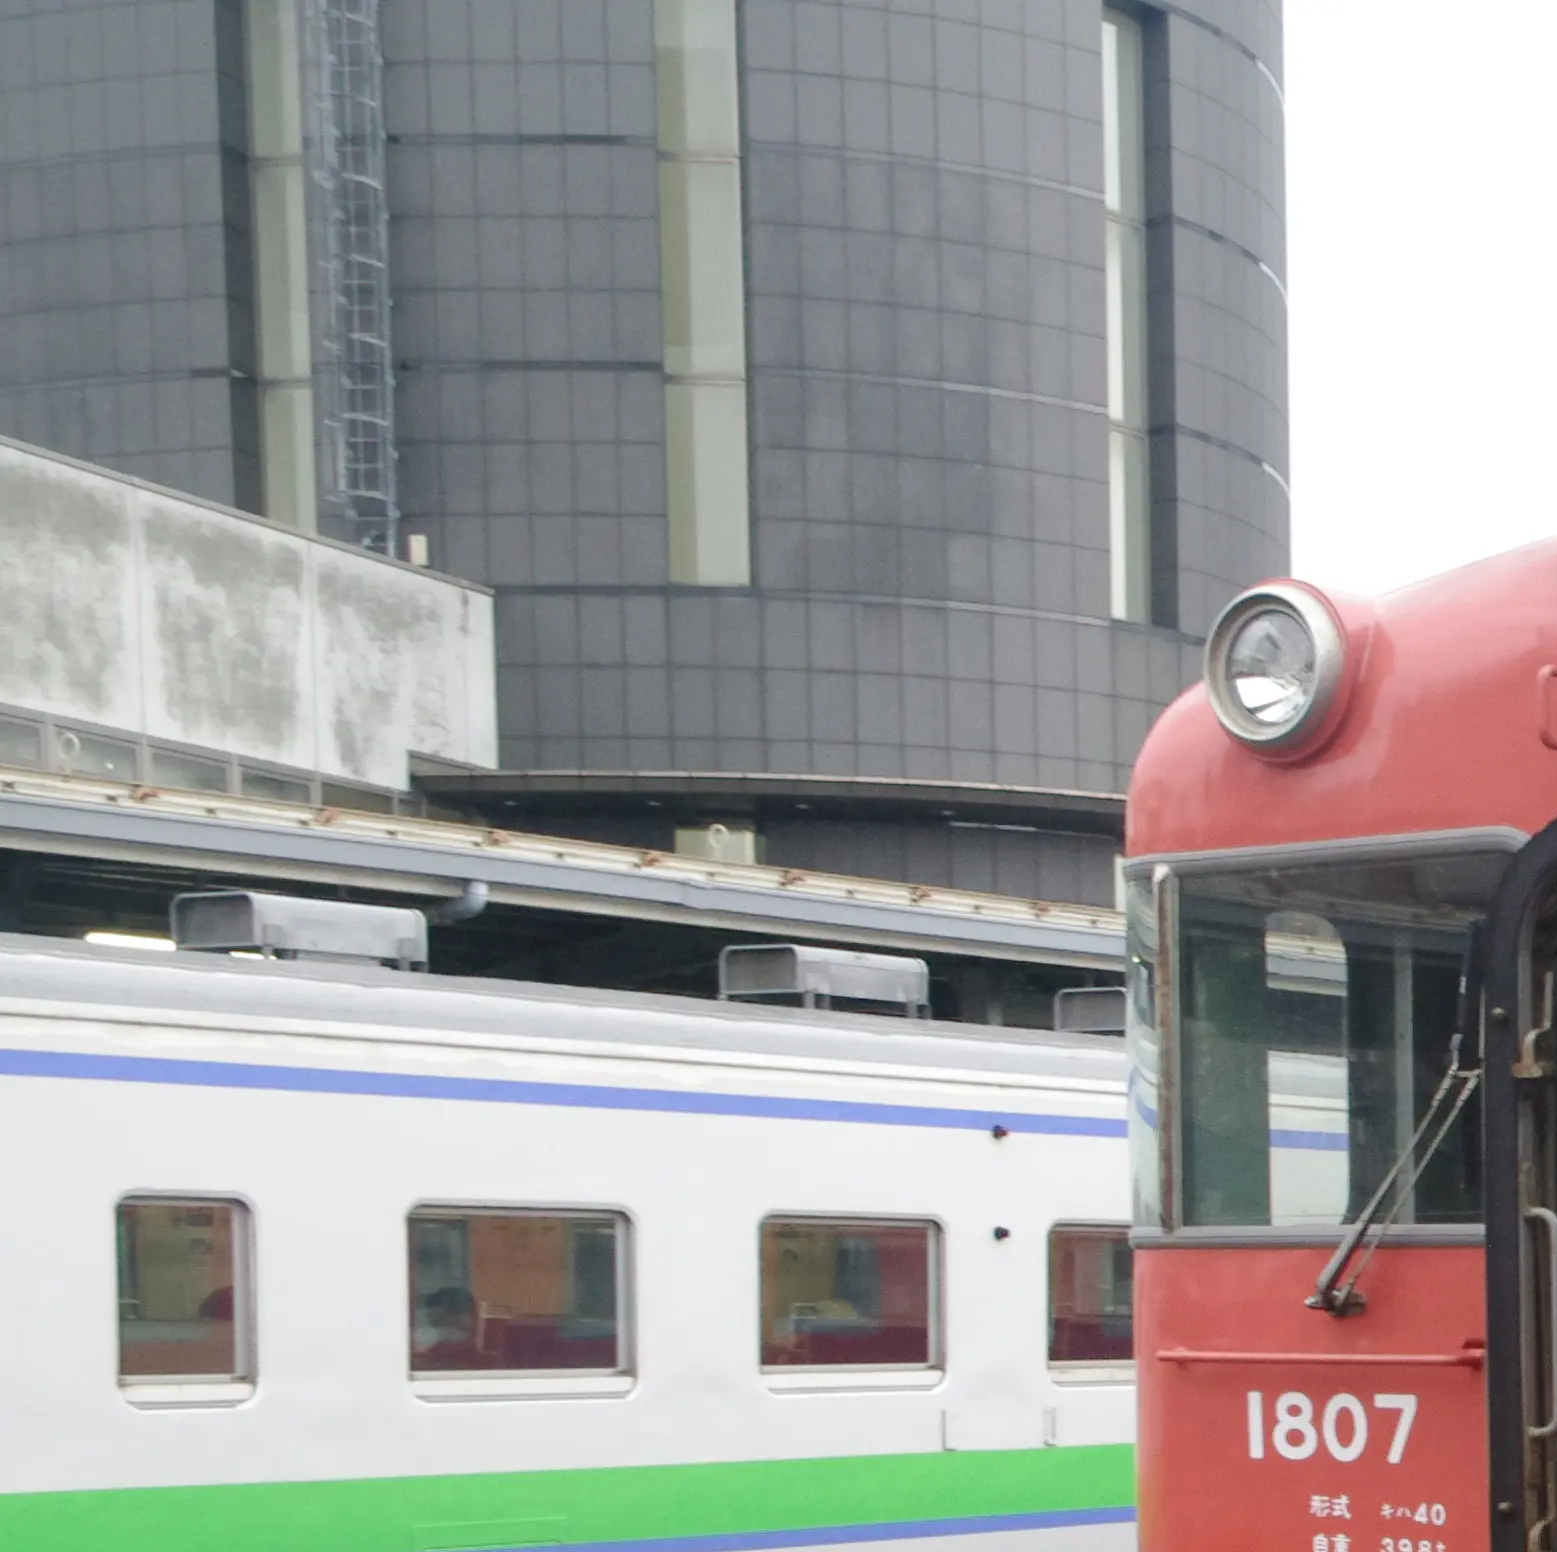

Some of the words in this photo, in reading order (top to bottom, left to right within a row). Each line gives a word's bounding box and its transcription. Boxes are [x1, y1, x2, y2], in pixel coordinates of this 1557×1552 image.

[1246, 1390, 1419, 1465] 1807
[1309, 1494, 1352, 1519] 形式
[1379, 1502, 1447, 1526] キハ40
